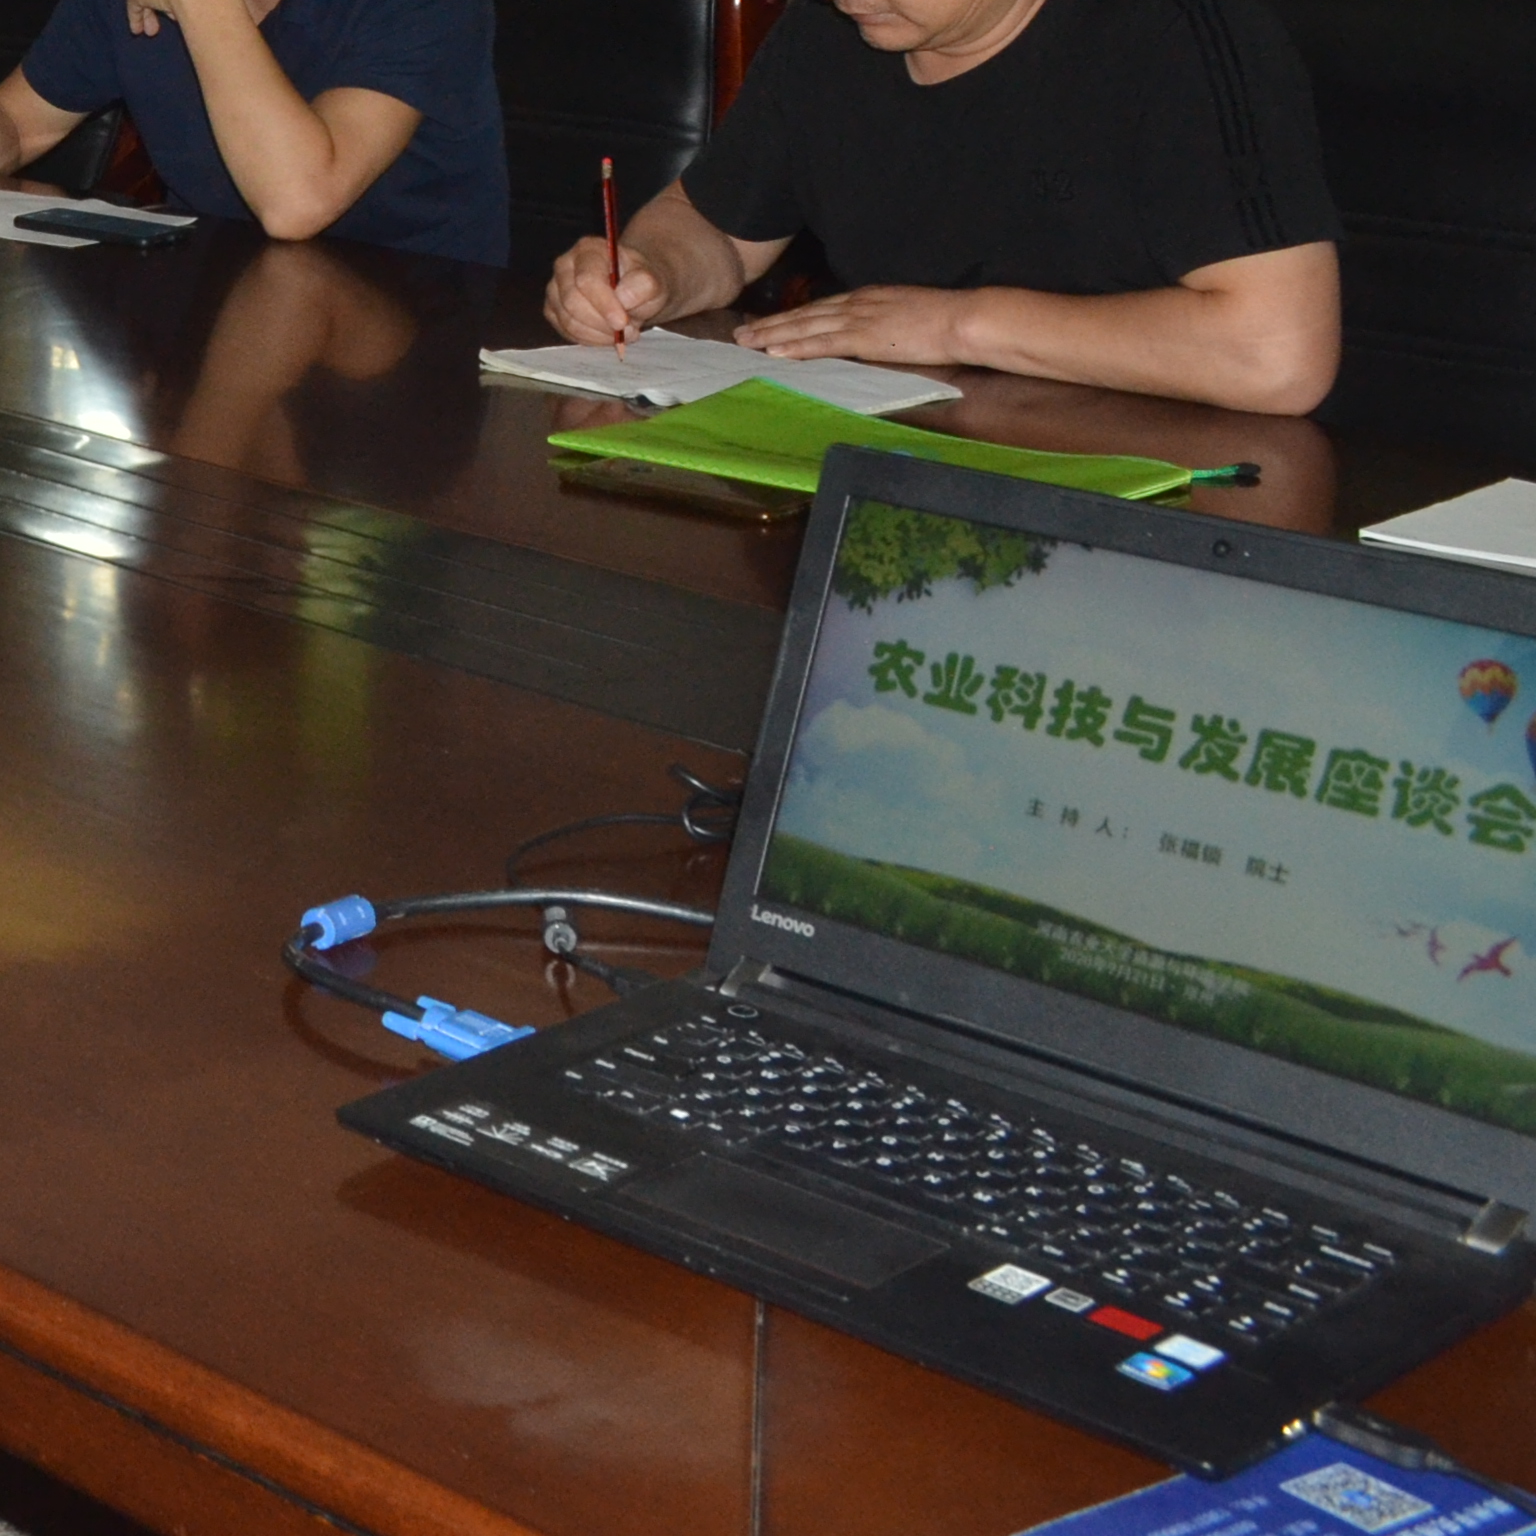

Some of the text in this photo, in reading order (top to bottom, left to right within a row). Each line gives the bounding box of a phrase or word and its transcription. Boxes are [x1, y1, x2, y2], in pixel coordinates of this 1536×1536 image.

[868, 640, 1536, 853] 农业科技与发展座谈会
[750, 904, 815, 939] Lenovo
